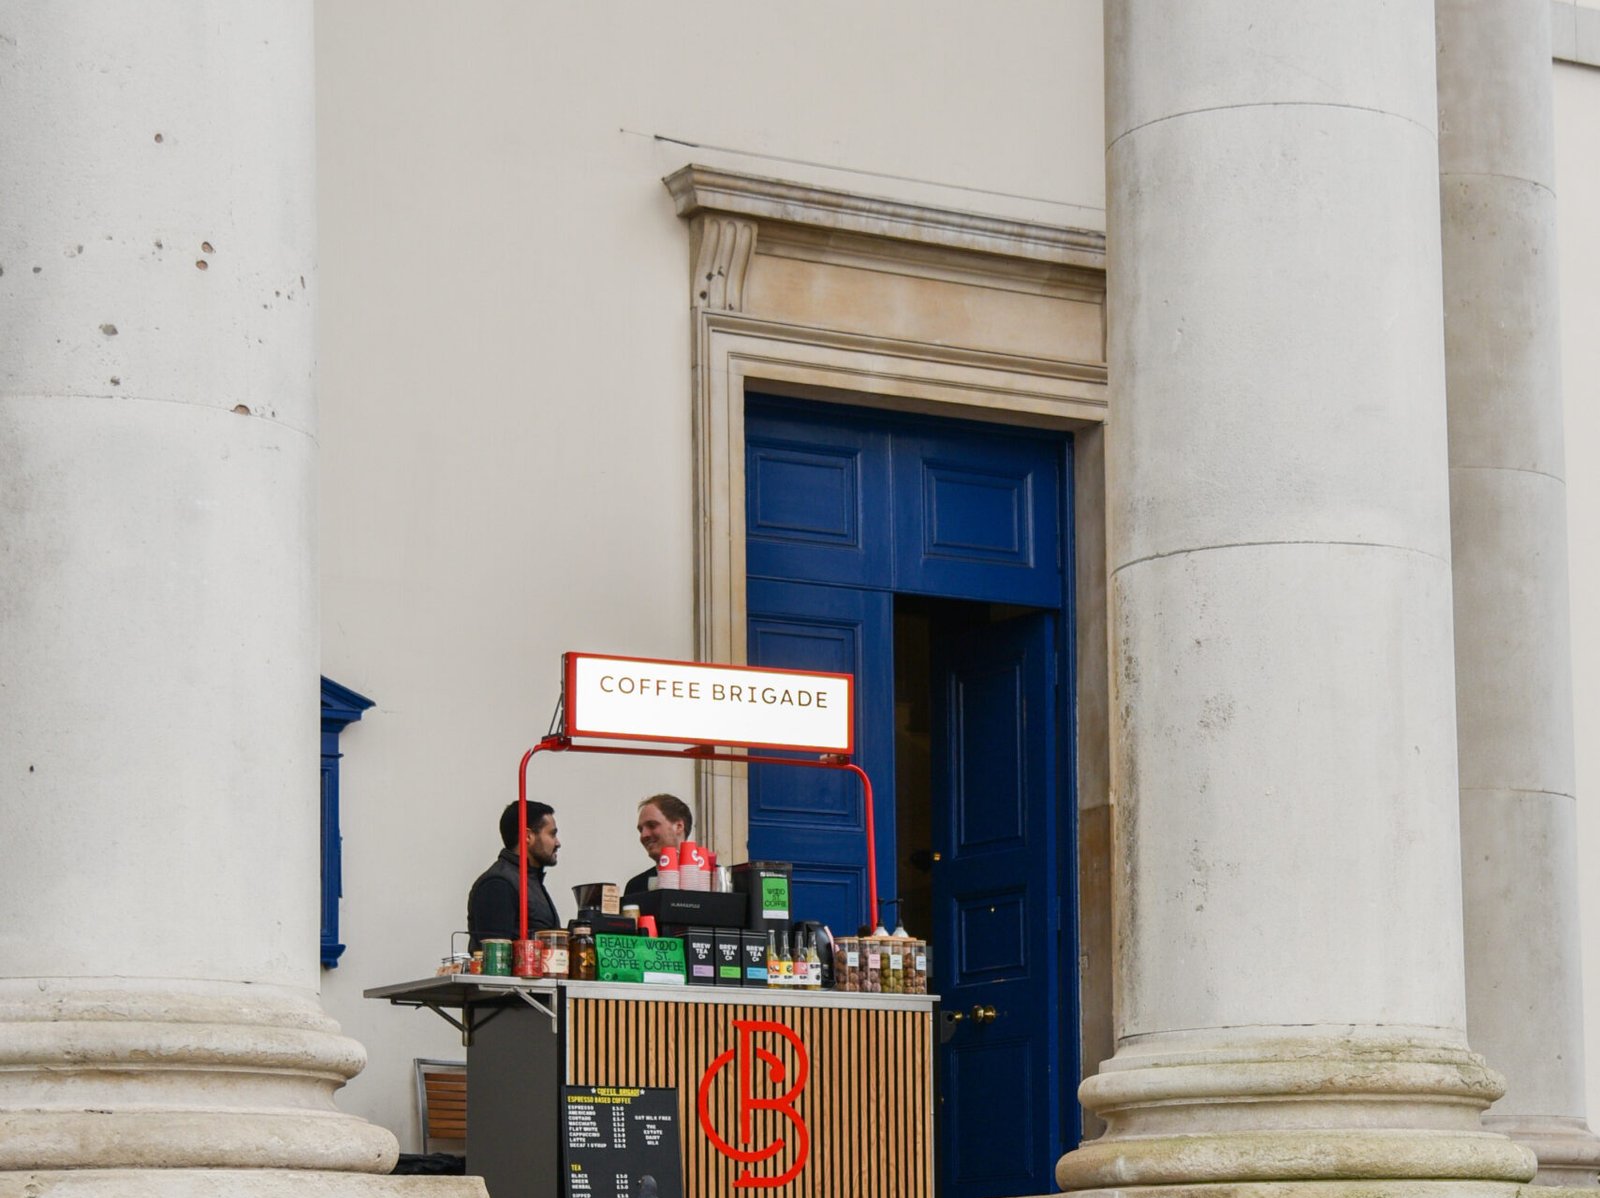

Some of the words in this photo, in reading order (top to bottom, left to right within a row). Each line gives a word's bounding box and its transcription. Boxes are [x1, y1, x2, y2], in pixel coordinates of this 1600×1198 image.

[600, 675, 701, 699] COFFEE
[712, 683, 828, 709] BRIGADE
[600, 936, 638, 949] REALLY
[645, 940, 678, 952] WOOD
[692, 942, 711, 950] BREW
[719, 943, 738, 951] BREW
[604, 948, 636, 959] GOOD
[746, 945, 765, 953] BREW
[600, 958, 640, 970] COFFEE
[644, 960, 684, 972] COFFEE
[595, 1096, 611, 1104] BASED
